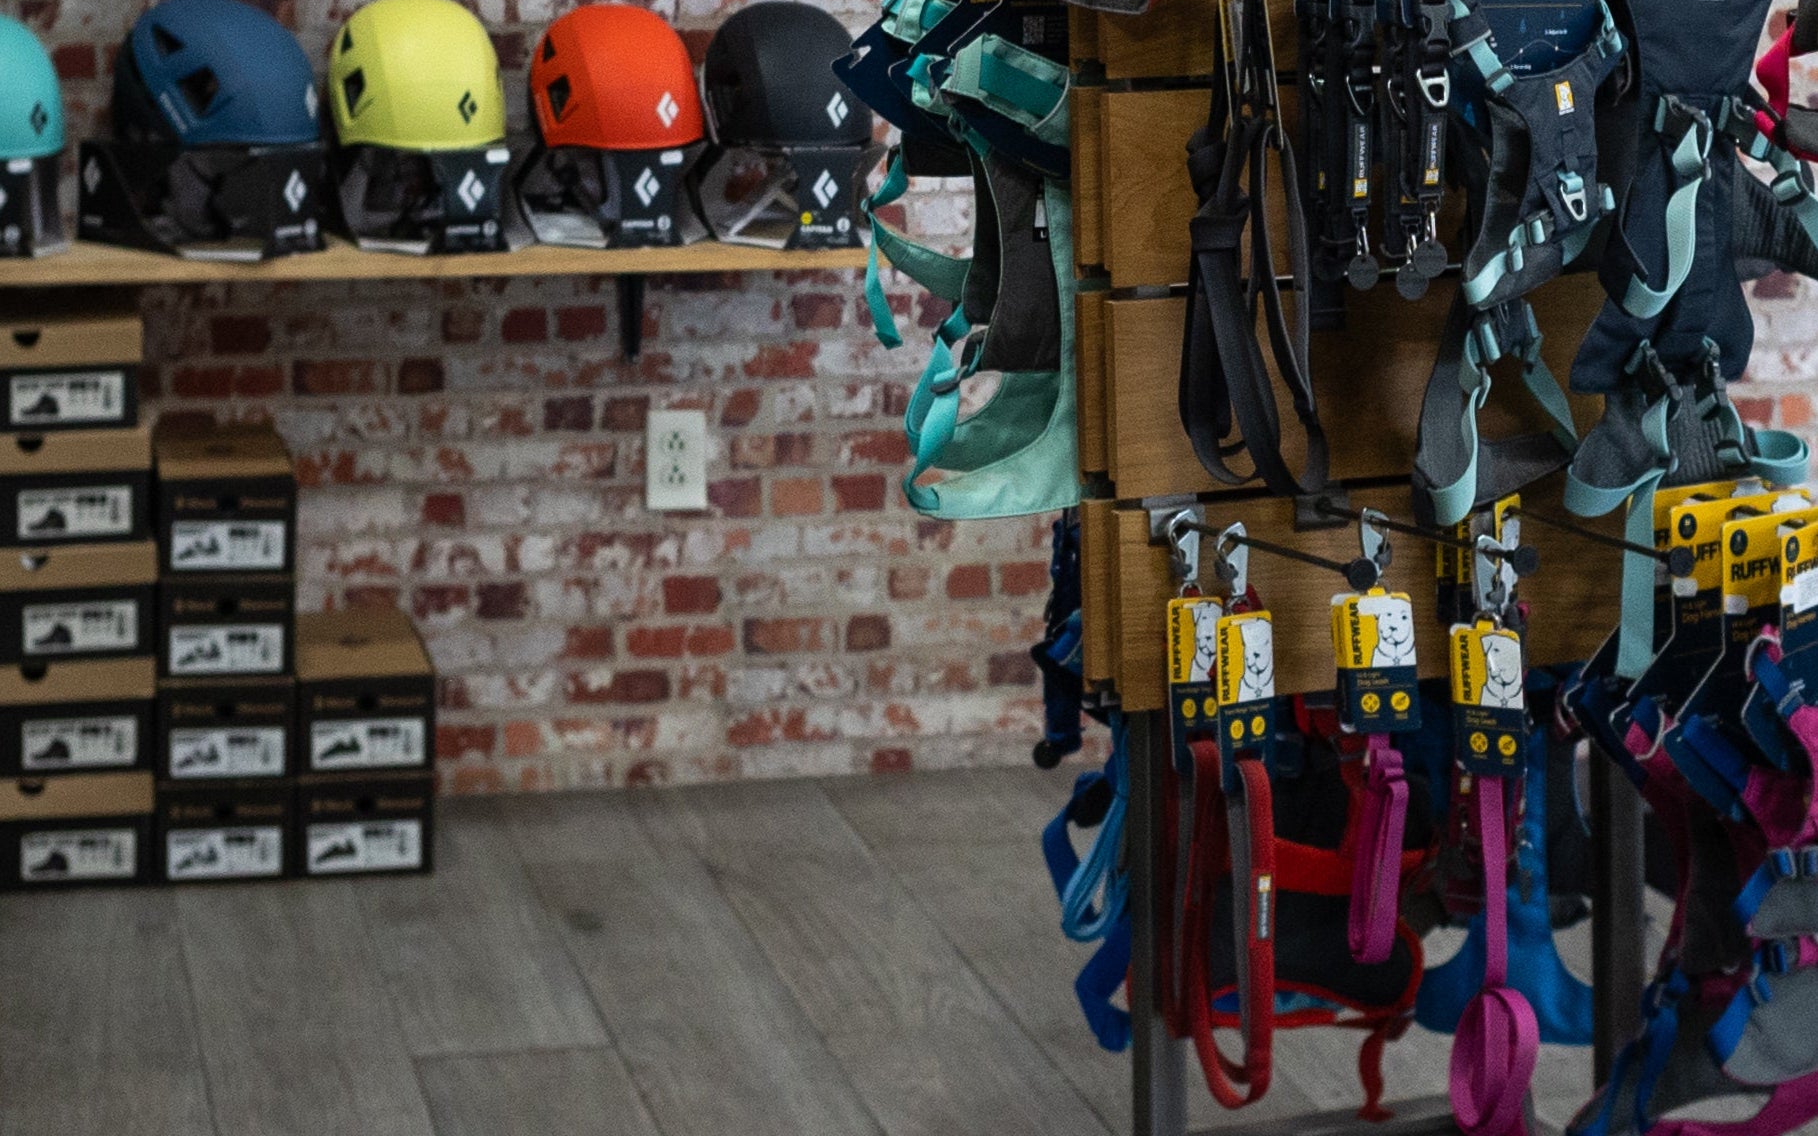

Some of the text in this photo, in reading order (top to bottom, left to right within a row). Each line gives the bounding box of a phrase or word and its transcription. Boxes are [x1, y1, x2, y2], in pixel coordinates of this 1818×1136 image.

[1172, 606, 1182, 680] RUFFWEAR
[1220, 626, 1231, 702] RUFFWEAR
[1349, 602, 1363, 666] RUFFWEAR
[1459, 634, 1472, 702] RUFFWEAR
